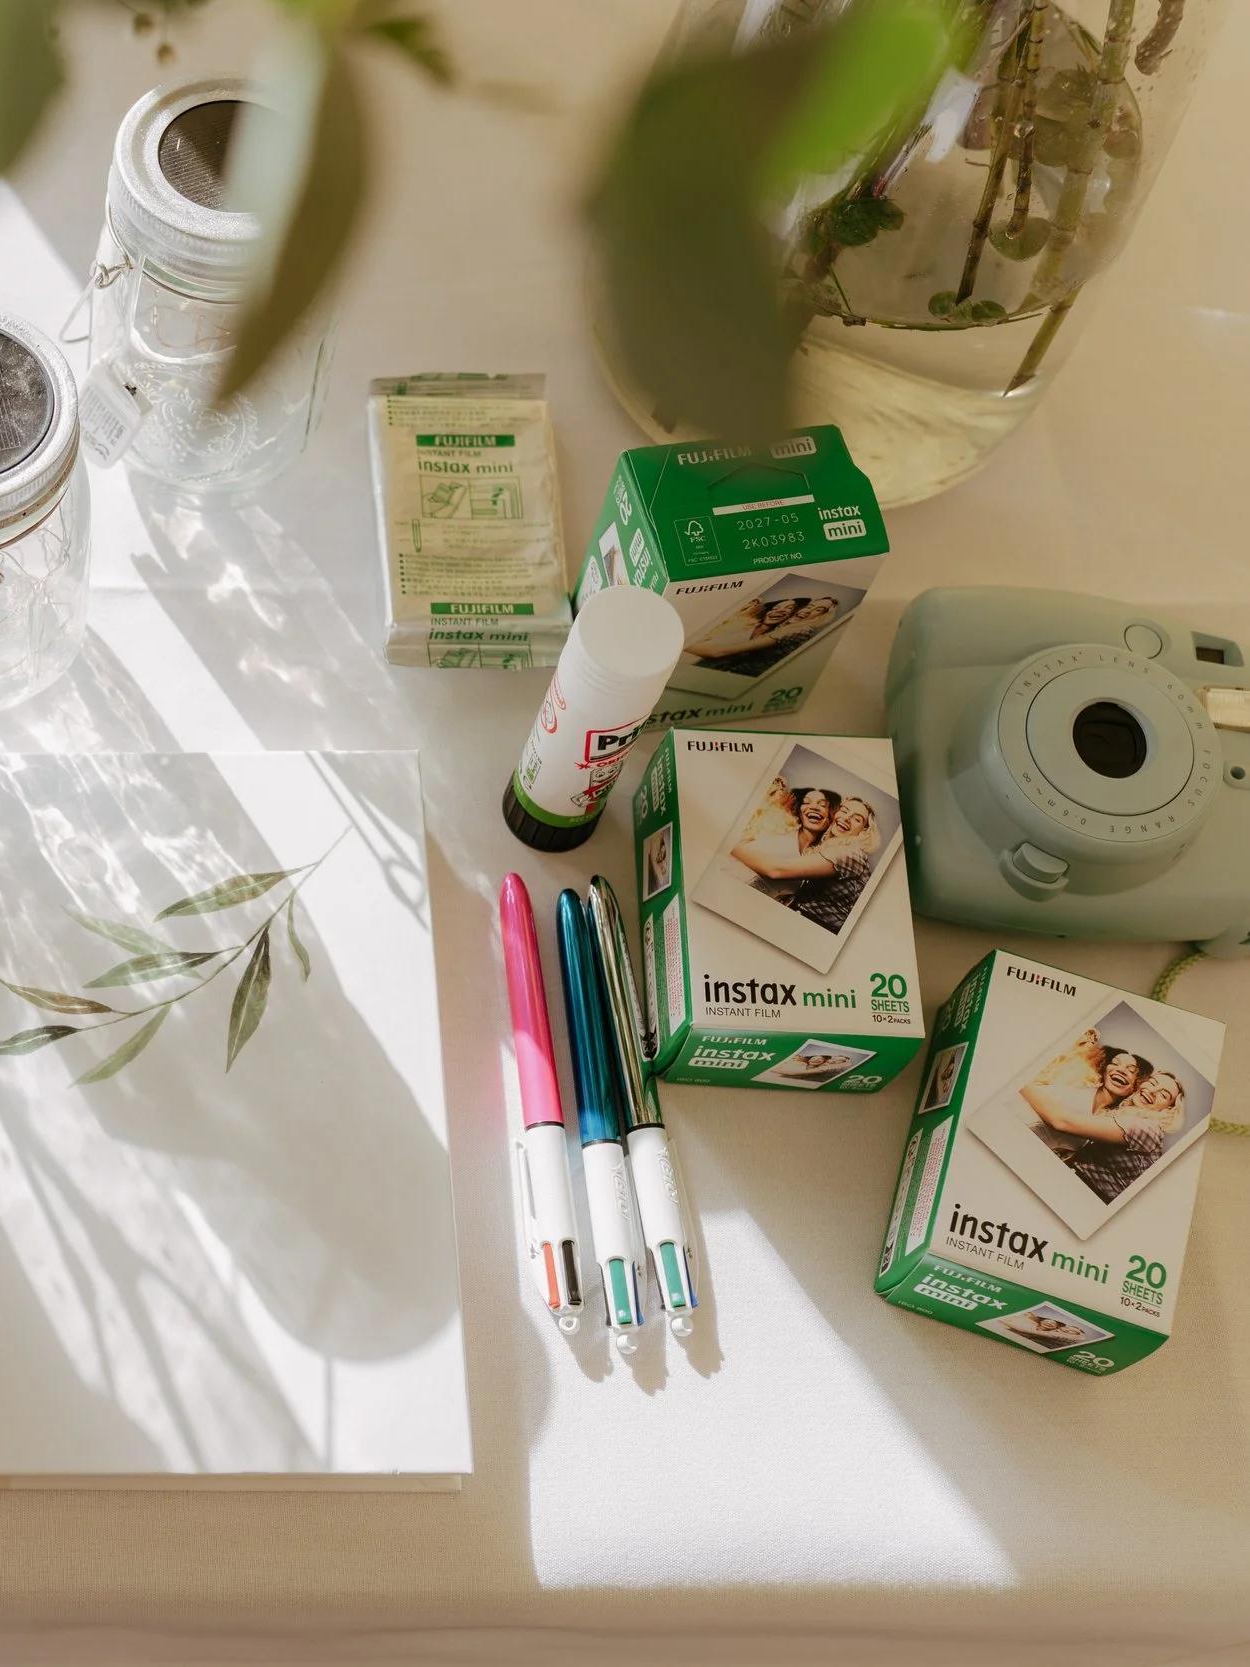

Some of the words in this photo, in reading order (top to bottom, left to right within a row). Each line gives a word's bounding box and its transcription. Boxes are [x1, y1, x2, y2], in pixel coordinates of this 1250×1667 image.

[435, 435, 497, 447] FUJIFILM
[677, 446, 752, 466] FUJIFILM
[418, 457, 471, 474] instax
[476, 461, 514, 474] mini
[758, 500, 785, 509] BEFORE
[817, 504, 862, 521] instax
[737, 512, 799, 531] 2027-05
[827, 521, 863, 539] mini
[742, 531, 805, 550] 2K03983
[753, 553, 788, 565] PRODUCT
[790, 551, 804, 560] NO.
[675, 580, 744, 595] FUJIFILM
[451, 603, 514, 615] FUJIFILM
[431, 617, 473, 626] INSTANT
[475, 618, 499, 627] FILM
[428, 628, 484, 641] instax
[489, 630, 528, 642] mini
[770, 686, 803, 701] 20
[646, 708, 703, 725] stax
[706, 702, 754, 717] mini
[687, 740, 754, 753] FUJIFILM
[870, 973, 908, 999] 20
[1006, 965, 1076, 997] FUJIFILM
[704, 974, 797, 1006] instax
[803, 989, 857, 1009] mini
[705, 1007, 753, 1018] INSTANT
[756, 1009, 781, 1019] FILM
[871, 999, 910, 1013] SHEETS
[702, 1036, 767, 1046] FUJIFILM
[694, 1046, 776, 1062] instax
[694, 1058, 744, 1069] mini
[847, 1075, 883, 1085] 20
[949, 1203, 1049, 1263] instax
[1051, 1250, 1110, 1285] mini
[946, 1236, 994, 1263] INSTANT
[996, 1254, 1025, 1271] FILM
[934, 1265, 1003, 1294] FUJIFILM
[1125, 1254, 1167, 1289] 20
[921, 1285, 973, 1310] mini
[922, 1273, 1008, 1310] instax
[1122, 1280, 1163, 1305] SHEETS
[1073, 1351, 1115, 1369] 20
